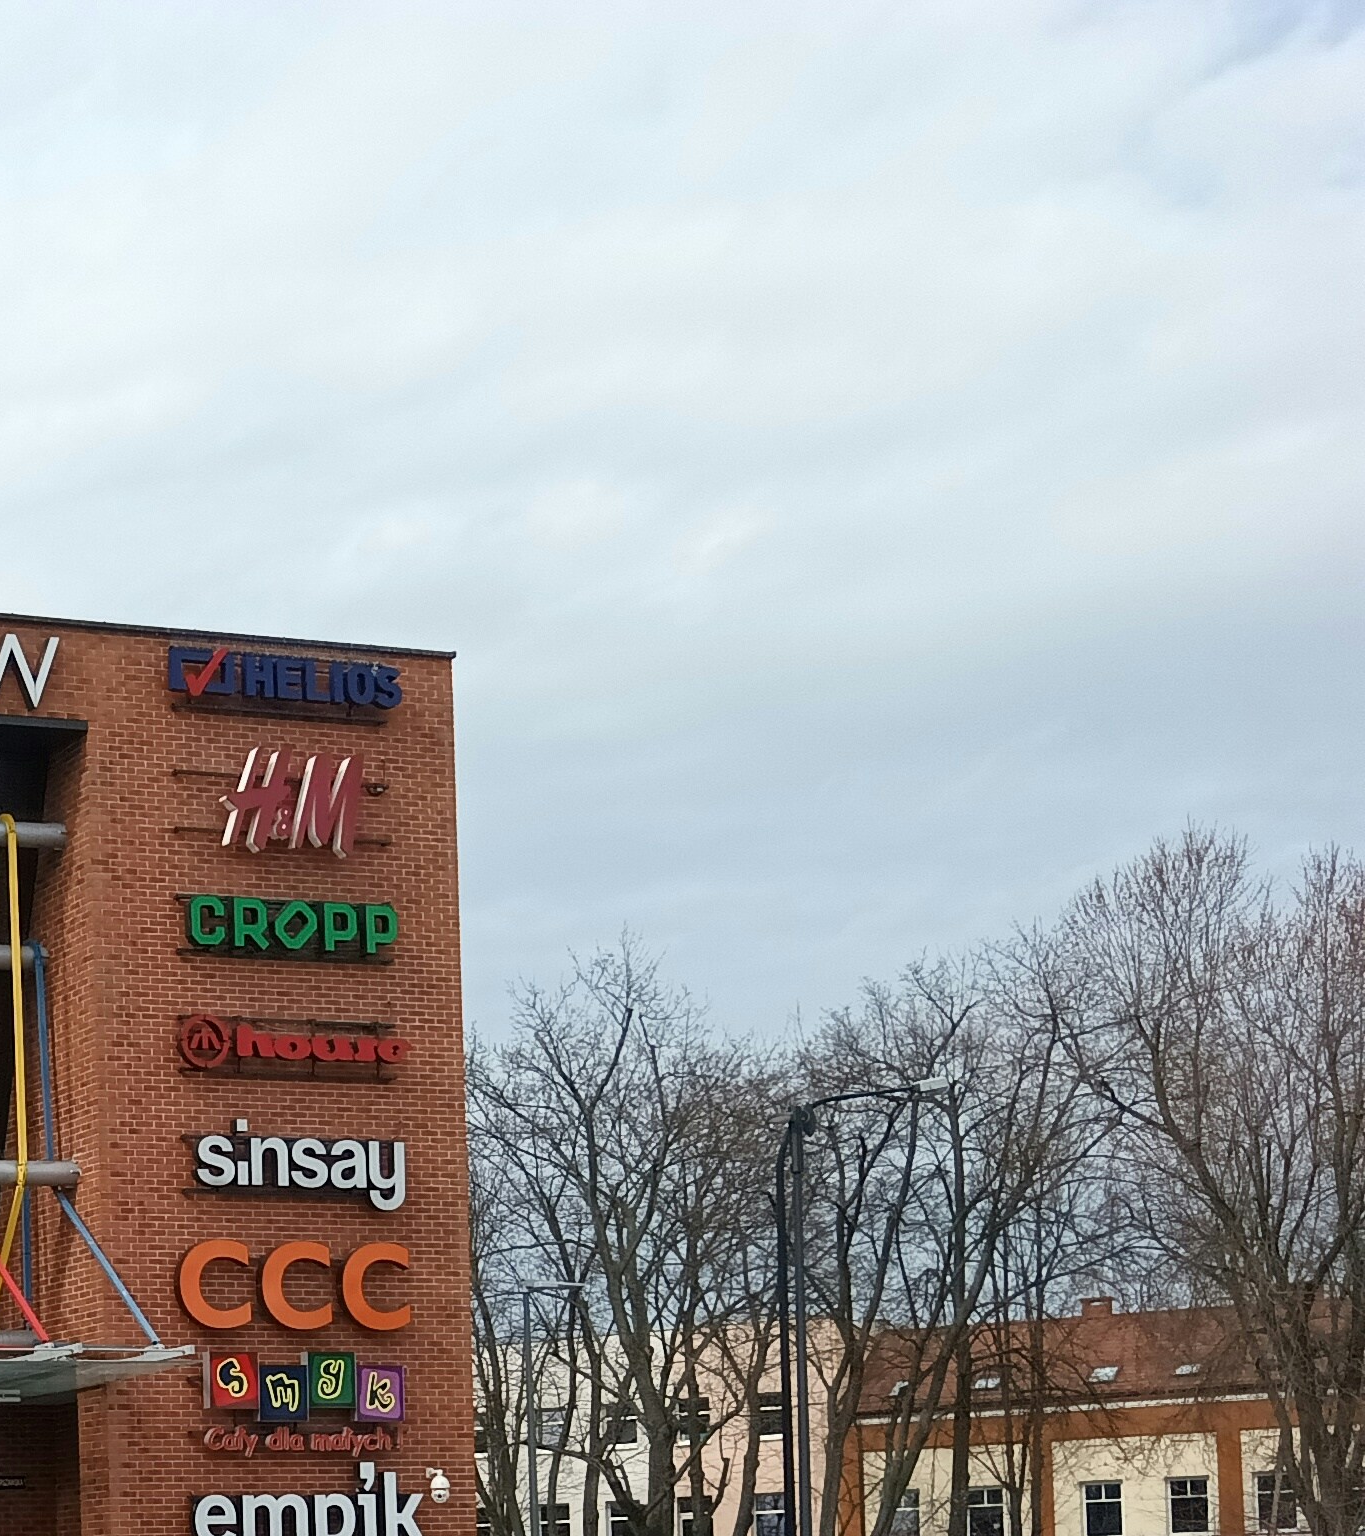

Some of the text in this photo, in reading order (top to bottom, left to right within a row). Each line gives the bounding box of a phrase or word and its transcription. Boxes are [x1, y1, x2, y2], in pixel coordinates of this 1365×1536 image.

[242, 653, 403, 710] HELIOS
[219, 744, 365, 860] H&M
[190, 895, 398, 954] CROPP
[236, 1025, 412, 1064] house
[196, 1117, 407, 1212] sinsay
[178, 1238, 412, 1330] CCC
[204, 1427, 259, 1458] Cały
[265, 1426, 305, 1451] dla
